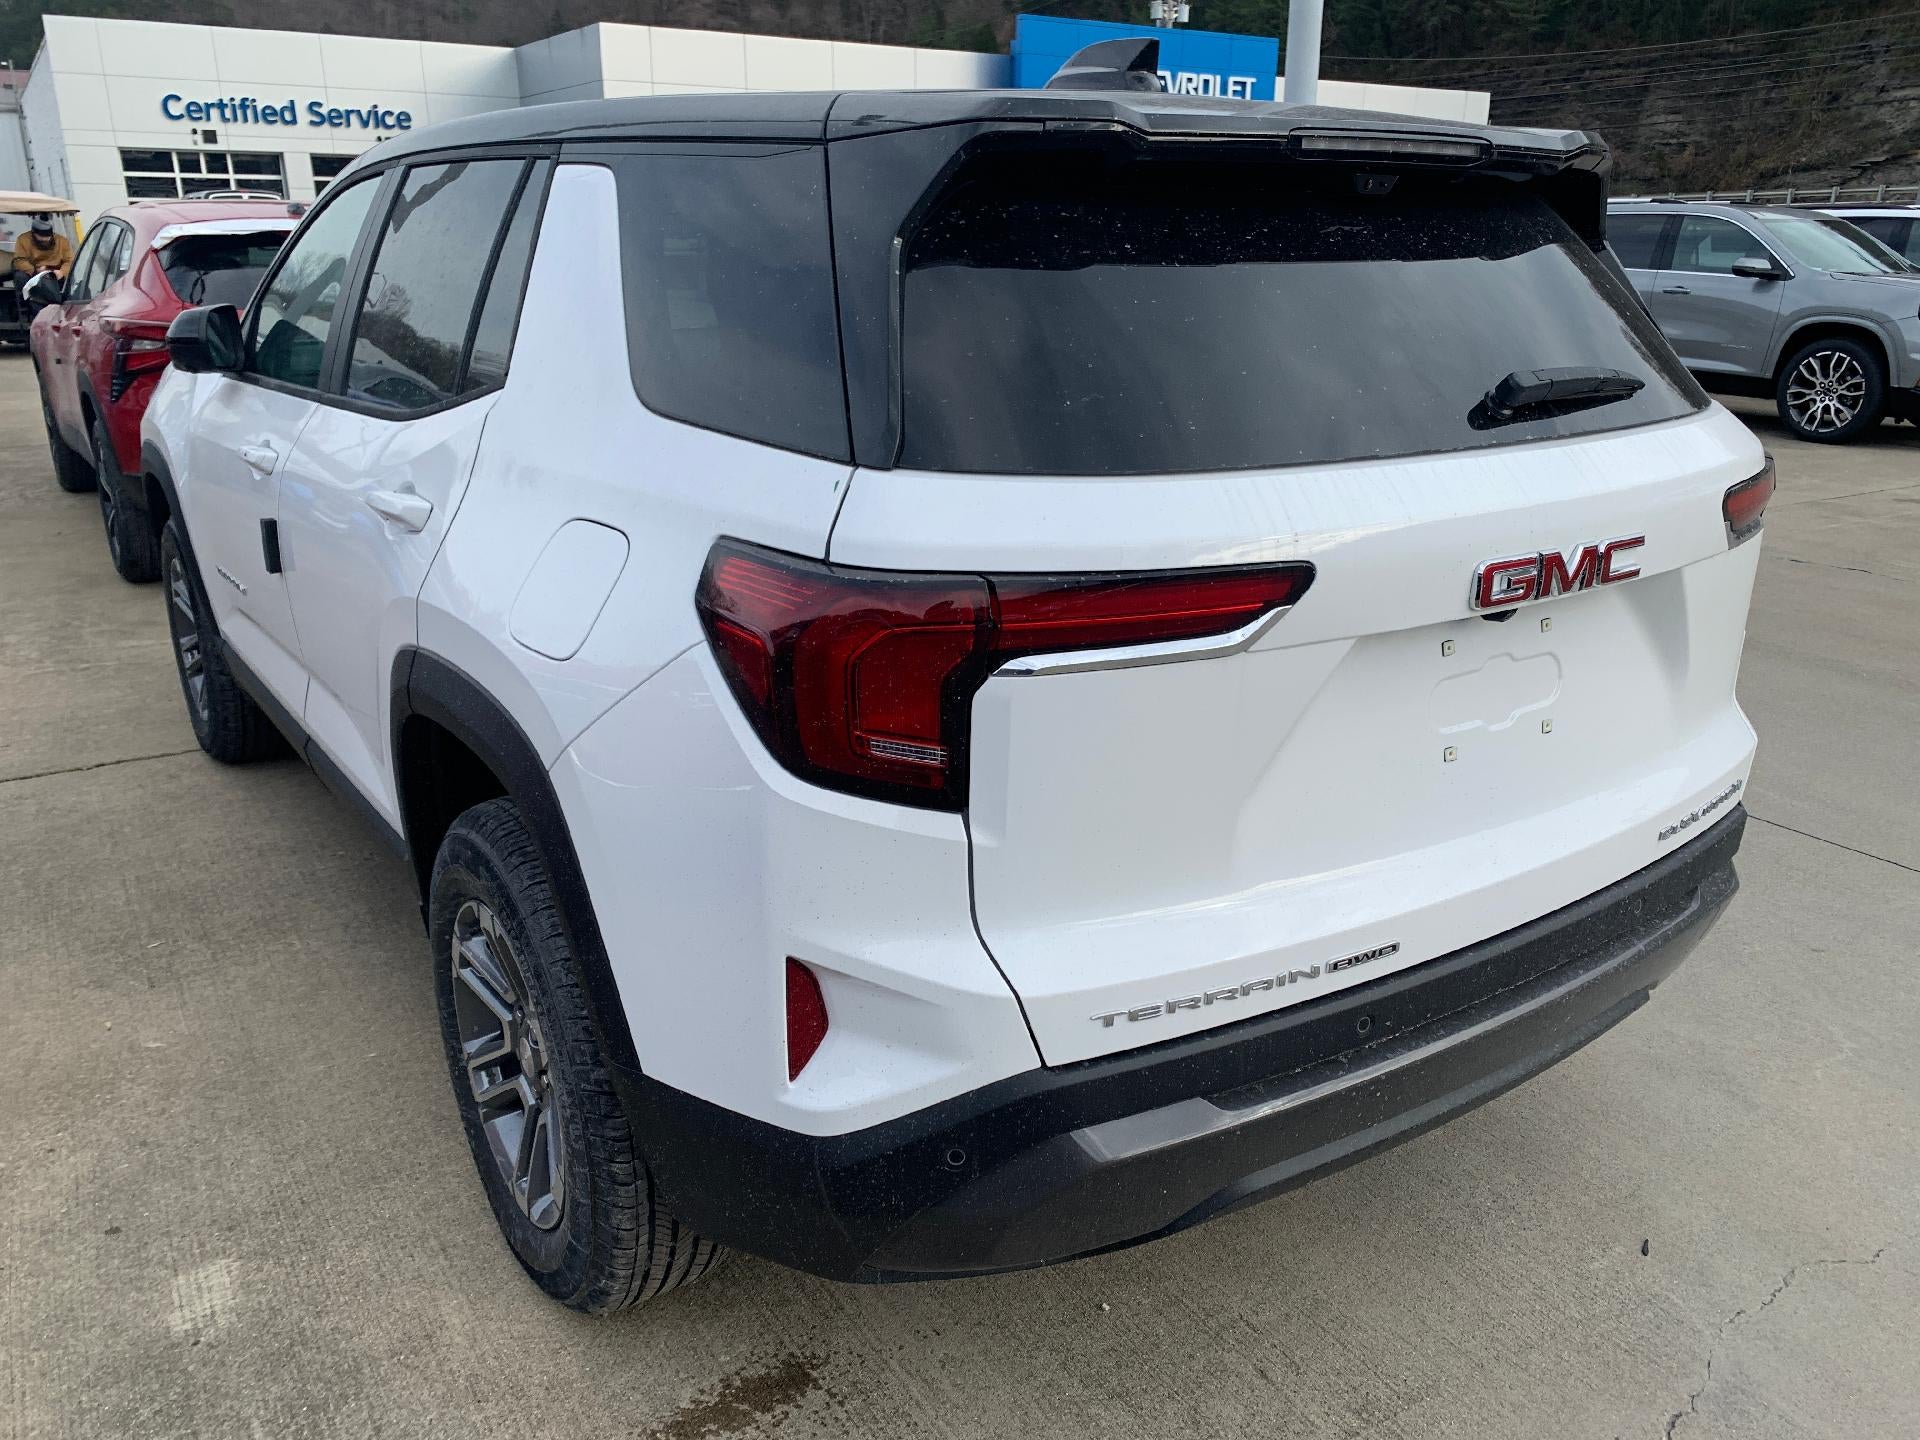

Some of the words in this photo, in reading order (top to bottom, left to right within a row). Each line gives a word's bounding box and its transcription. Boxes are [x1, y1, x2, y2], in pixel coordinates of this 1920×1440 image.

[162, 94, 298, 125] Certified
[308, 101, 412, 130] Service
[1470, 532, 1646, 610] GMC
[1090, 964, 1321, 1028] TERRAIN
[1331, 944, 1399, 972] AWD
